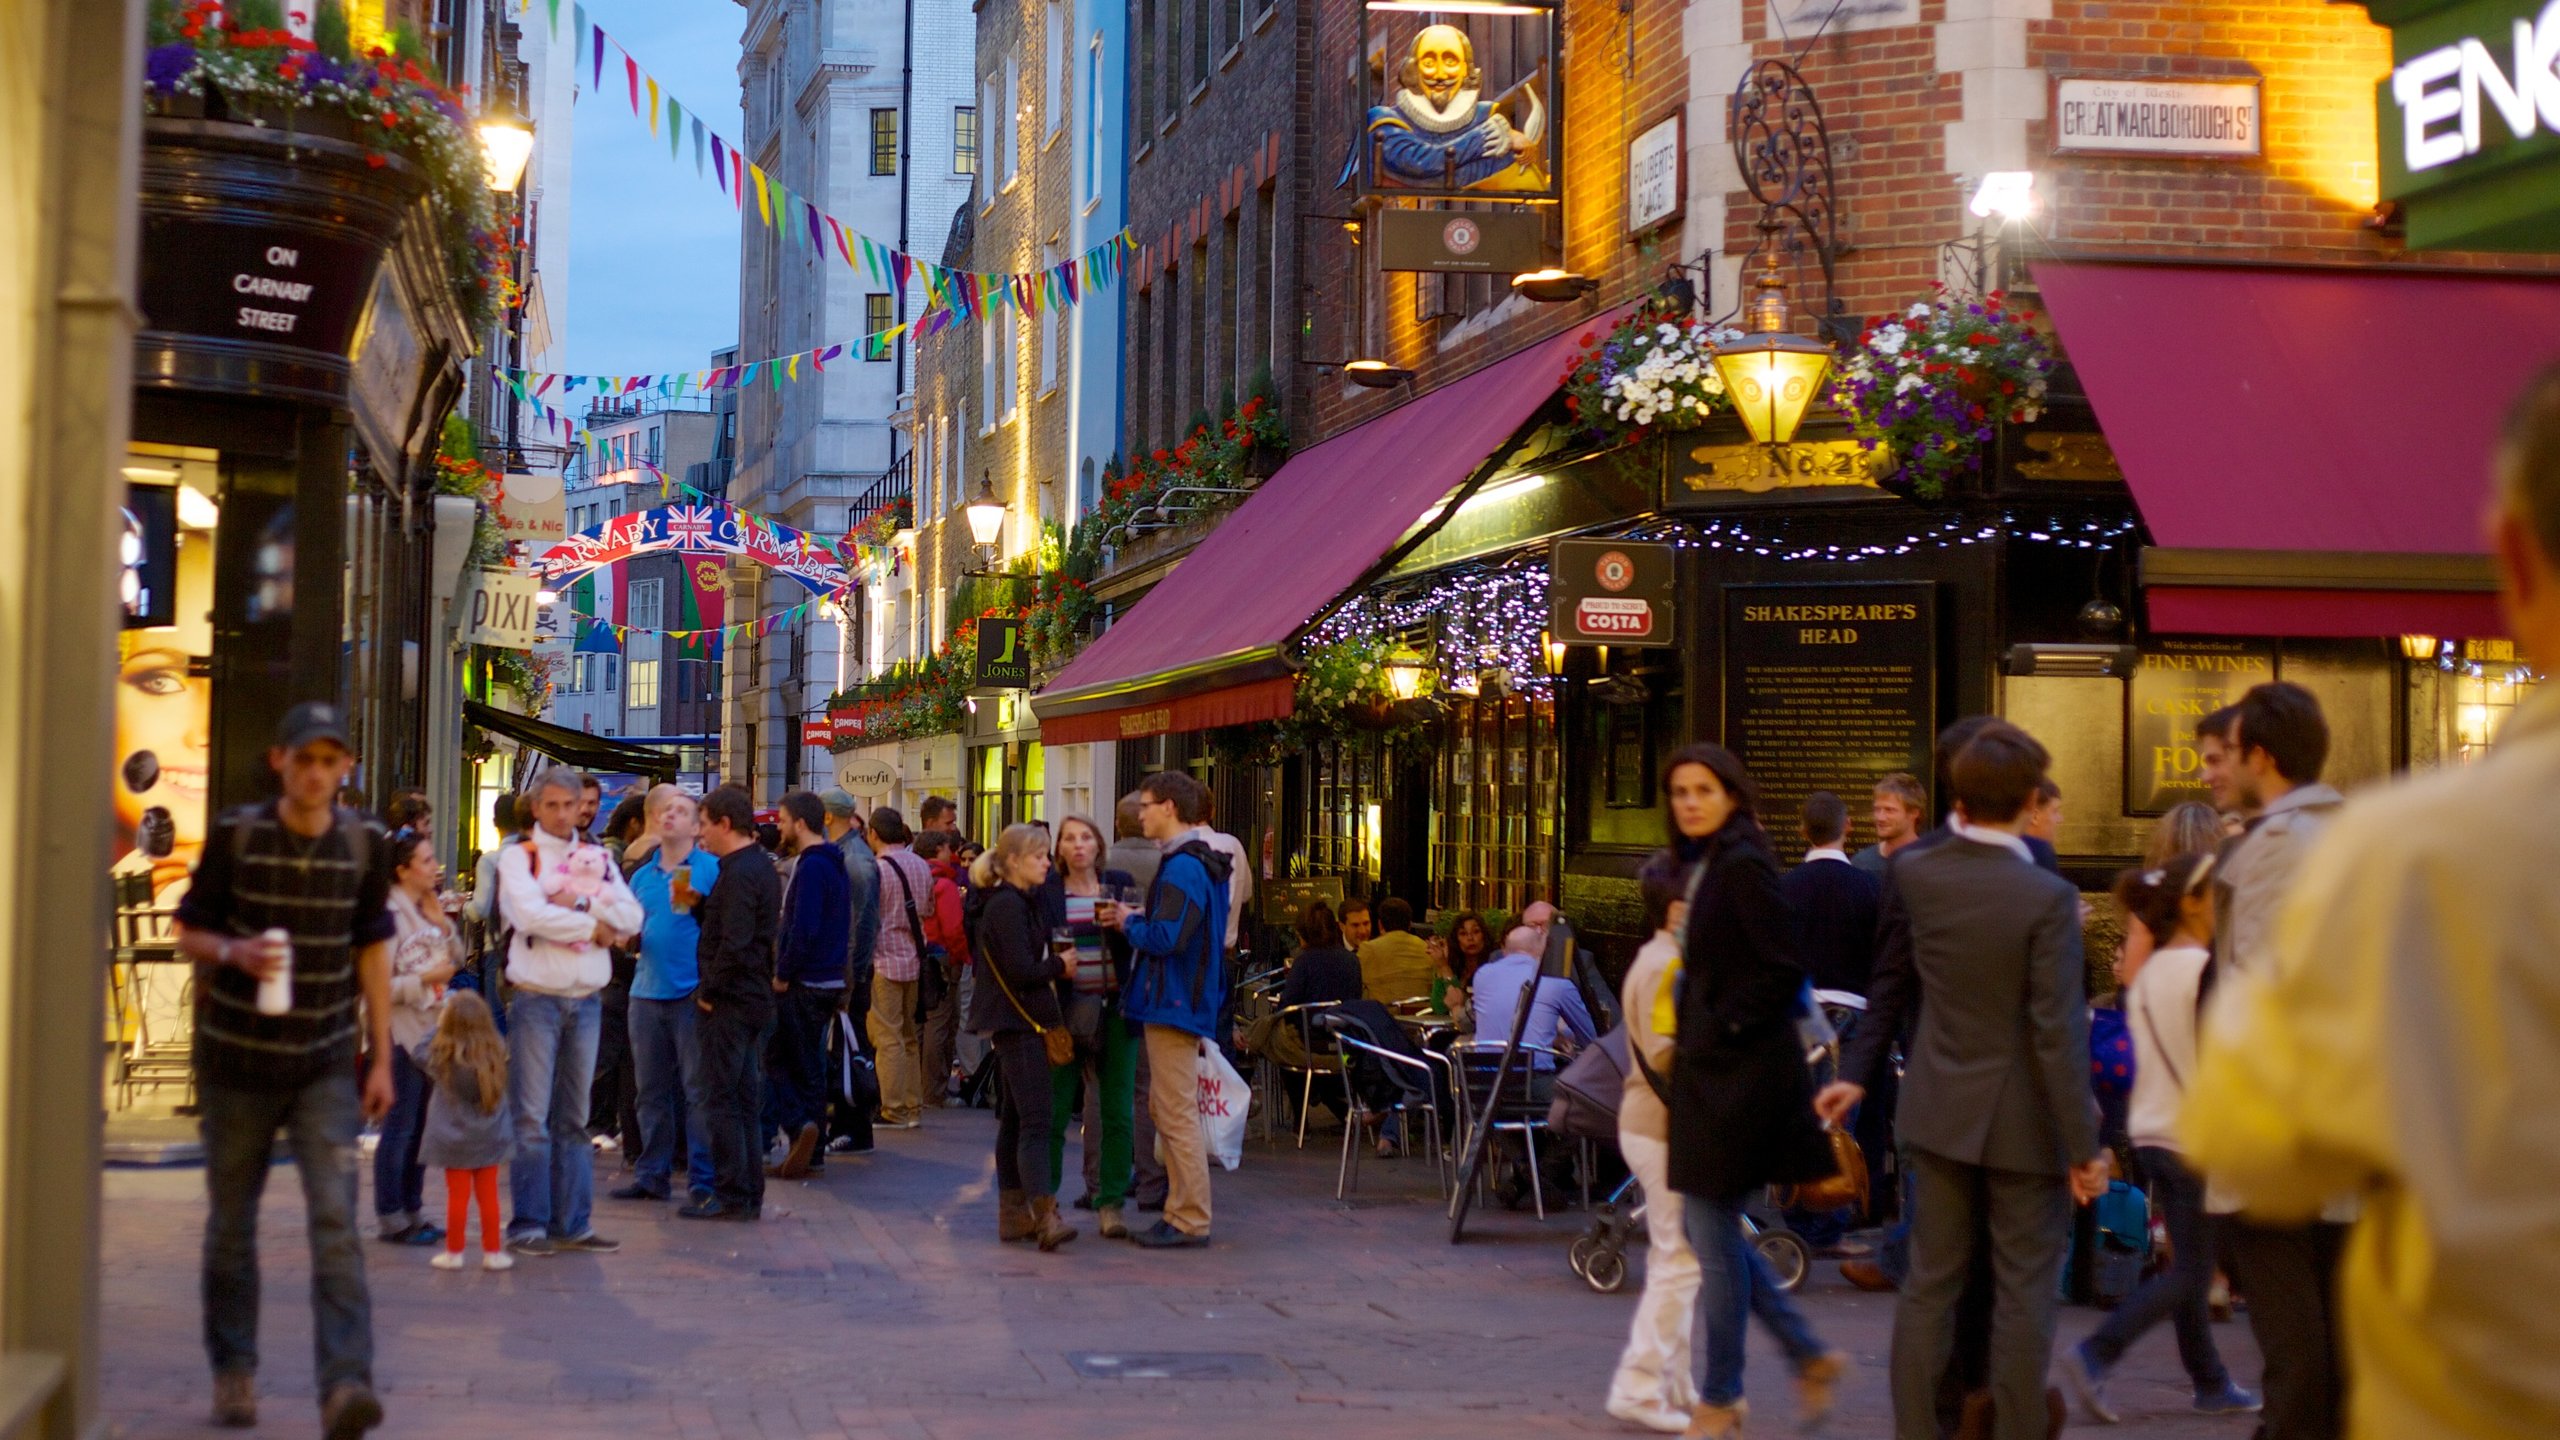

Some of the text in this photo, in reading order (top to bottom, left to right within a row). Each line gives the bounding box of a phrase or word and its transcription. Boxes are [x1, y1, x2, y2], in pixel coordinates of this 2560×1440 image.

[2064, 101, 2114, 138] GREAT
[2117, 102, 2233, 140] MARLBOROUGH
[265, 246, 299, 268] ON
[234, 273, 314, 302] CARNABY
[238, 307, 299, 332] STREET
[528, 519, 537, 530] &
[673, 523, 706, 532] CARNABY
[543, 518, 660, 581] CARNABY
[718, 519, 839, 587] CARNABY
[1744, 604, 1917, 621] SHAKESPEARE'S
[1586, 614, 1641, 631] COSTA
[1800, 628, 1858, 644] HEAD
[2163, 640, 2188, 650] Wide
[982, 664, 1025, 678] JONES
[2143, 654, 2265, 673] FINE WINES
[834, 717, 862, 730] CAMPER
[806, 730, 832, 741] CAMPER
[846, 771, 889, 785] benefit
